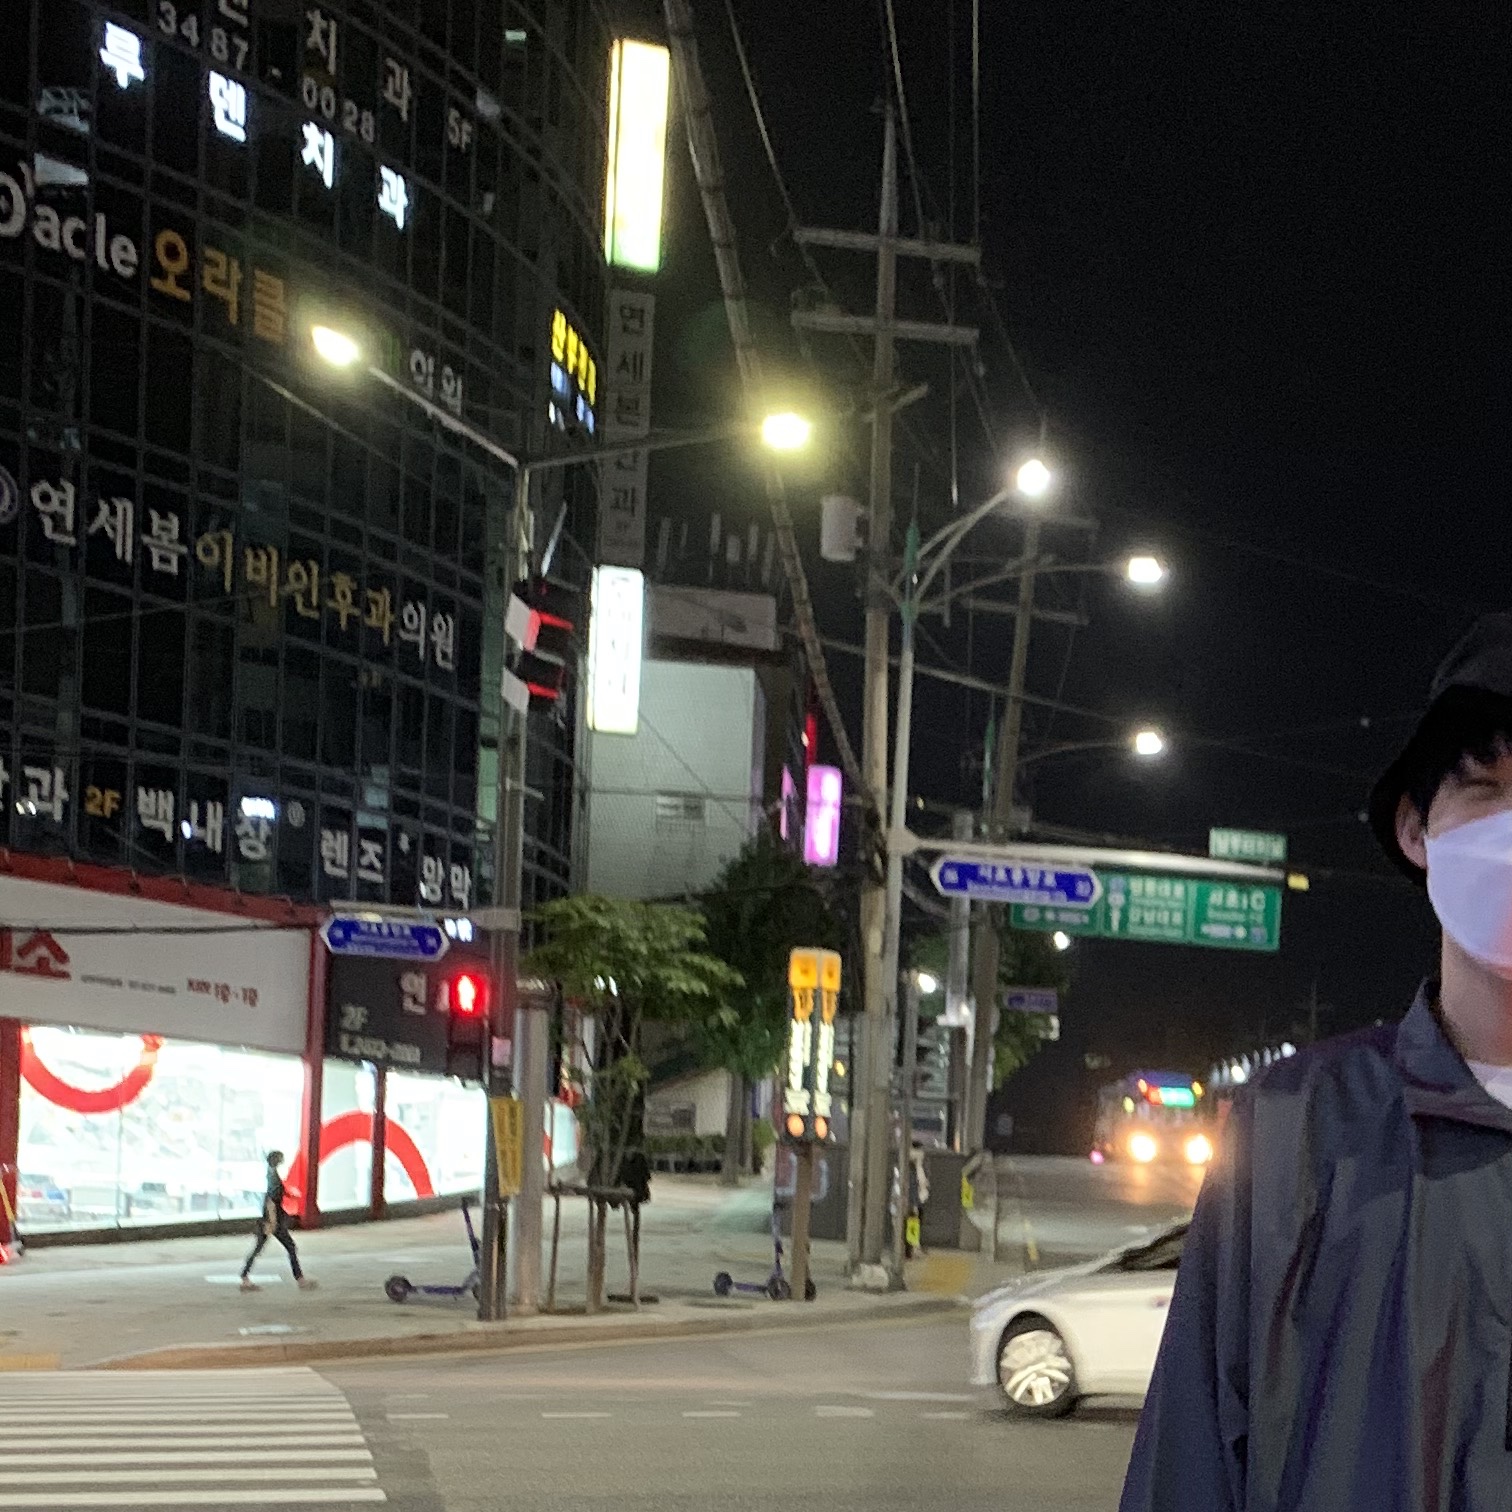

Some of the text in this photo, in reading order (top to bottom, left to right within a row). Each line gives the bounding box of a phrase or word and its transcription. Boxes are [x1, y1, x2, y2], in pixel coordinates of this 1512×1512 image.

[84, 784, 121, 818] 2F
[320, 827, 384, 884] 렌즈
[421, 854, 471, 911] 망막
